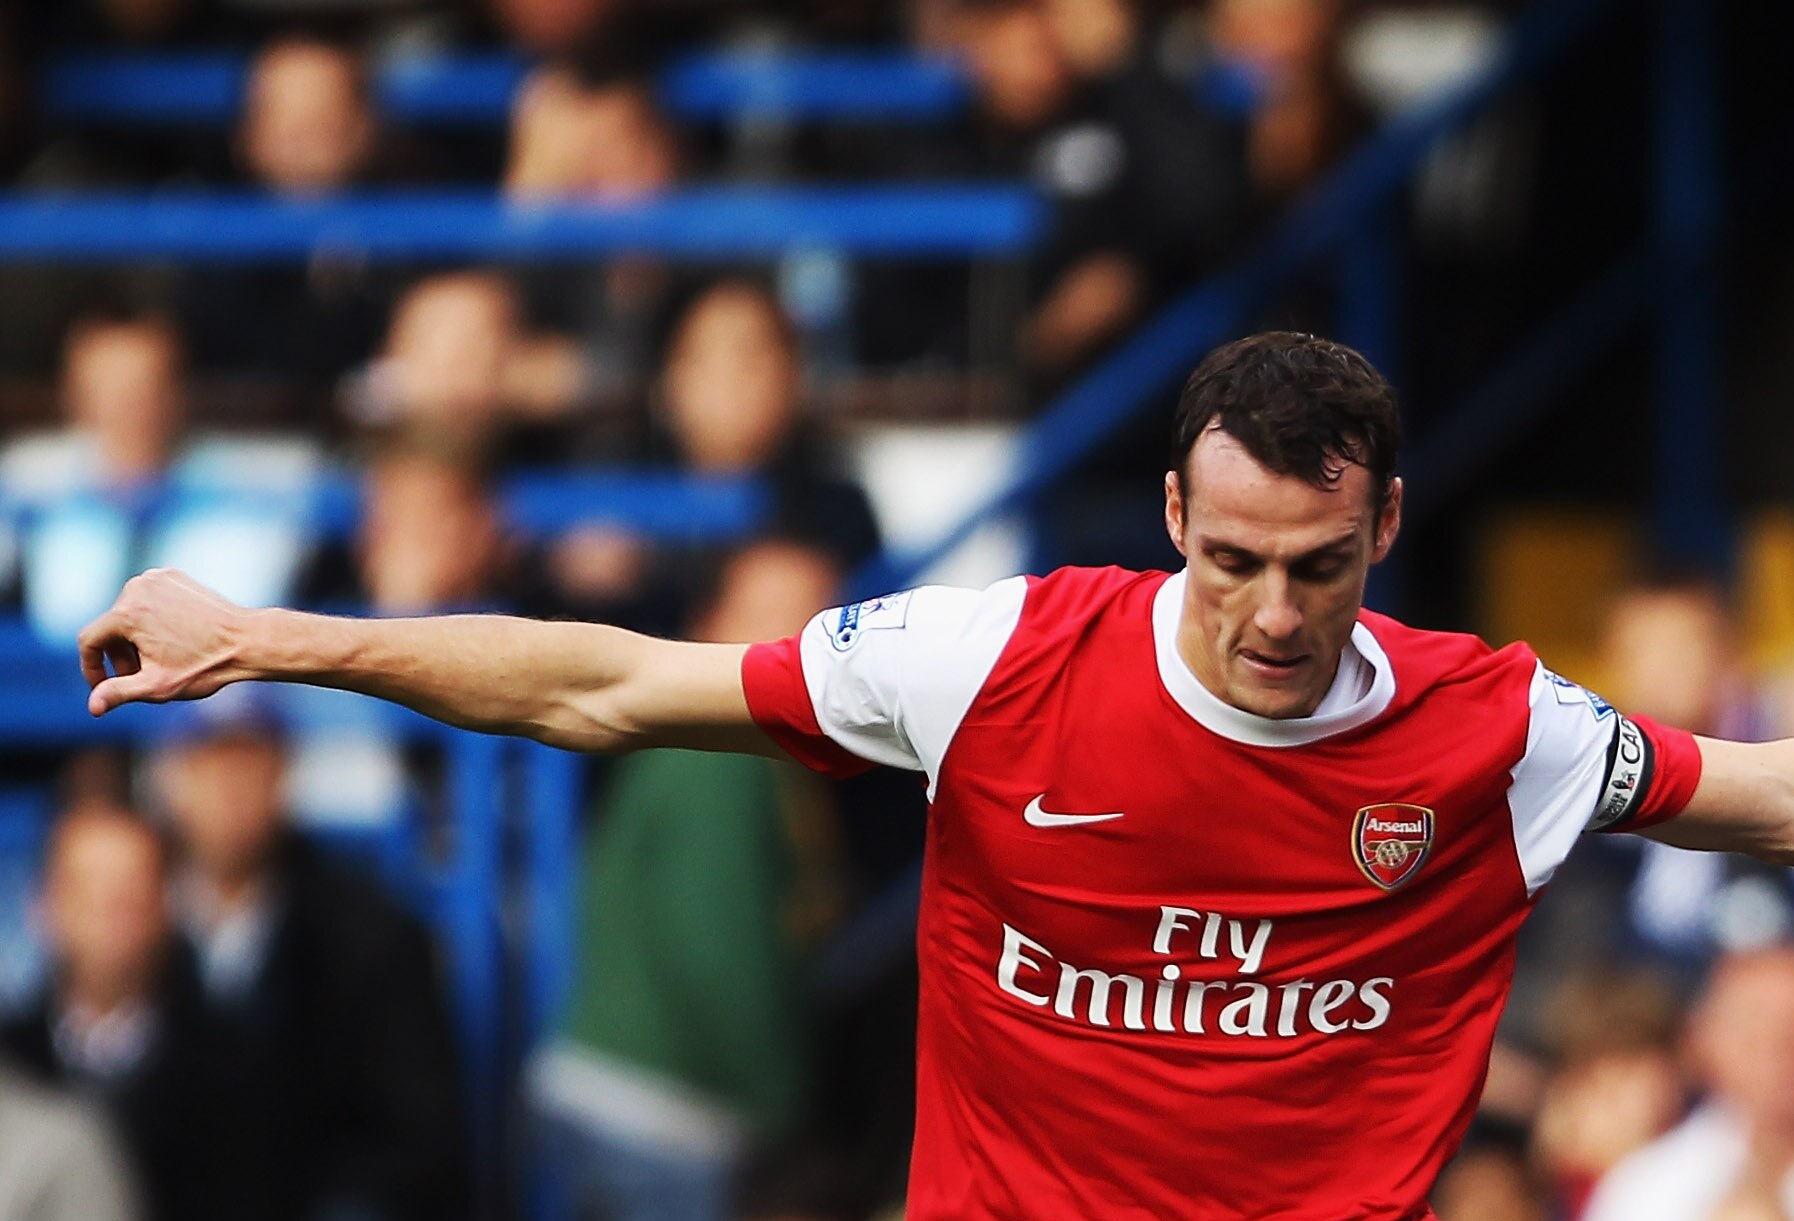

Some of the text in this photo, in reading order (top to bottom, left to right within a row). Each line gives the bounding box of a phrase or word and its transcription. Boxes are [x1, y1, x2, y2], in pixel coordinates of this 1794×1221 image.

[1366, 818, 1422, 833] Arsenal
[1152, 905, 1273, 974] Fly
[997, 922, 1394, 1037] Emirates
